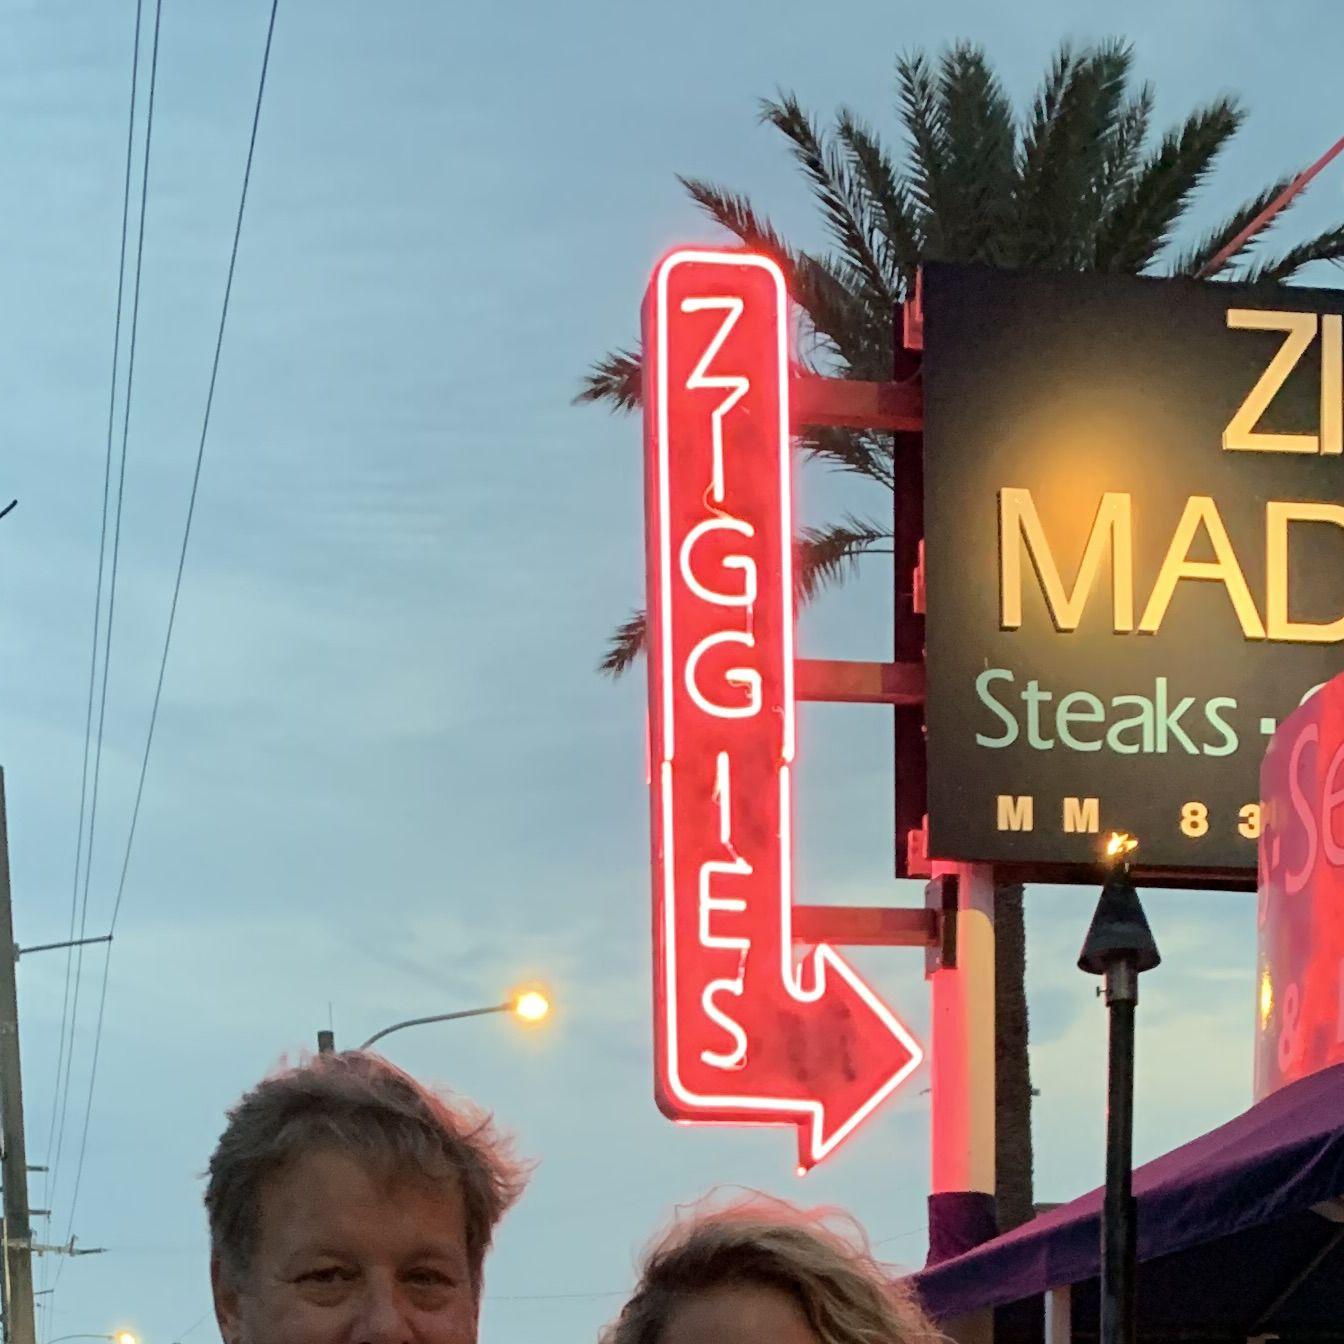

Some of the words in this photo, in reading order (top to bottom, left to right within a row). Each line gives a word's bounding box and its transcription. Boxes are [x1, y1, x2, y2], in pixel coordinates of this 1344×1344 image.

[678, 296, 762, 1070] ZIGGIES
[974, 667, 1240, 757] Steaks
[1276, 982, 1303, 1073] &
